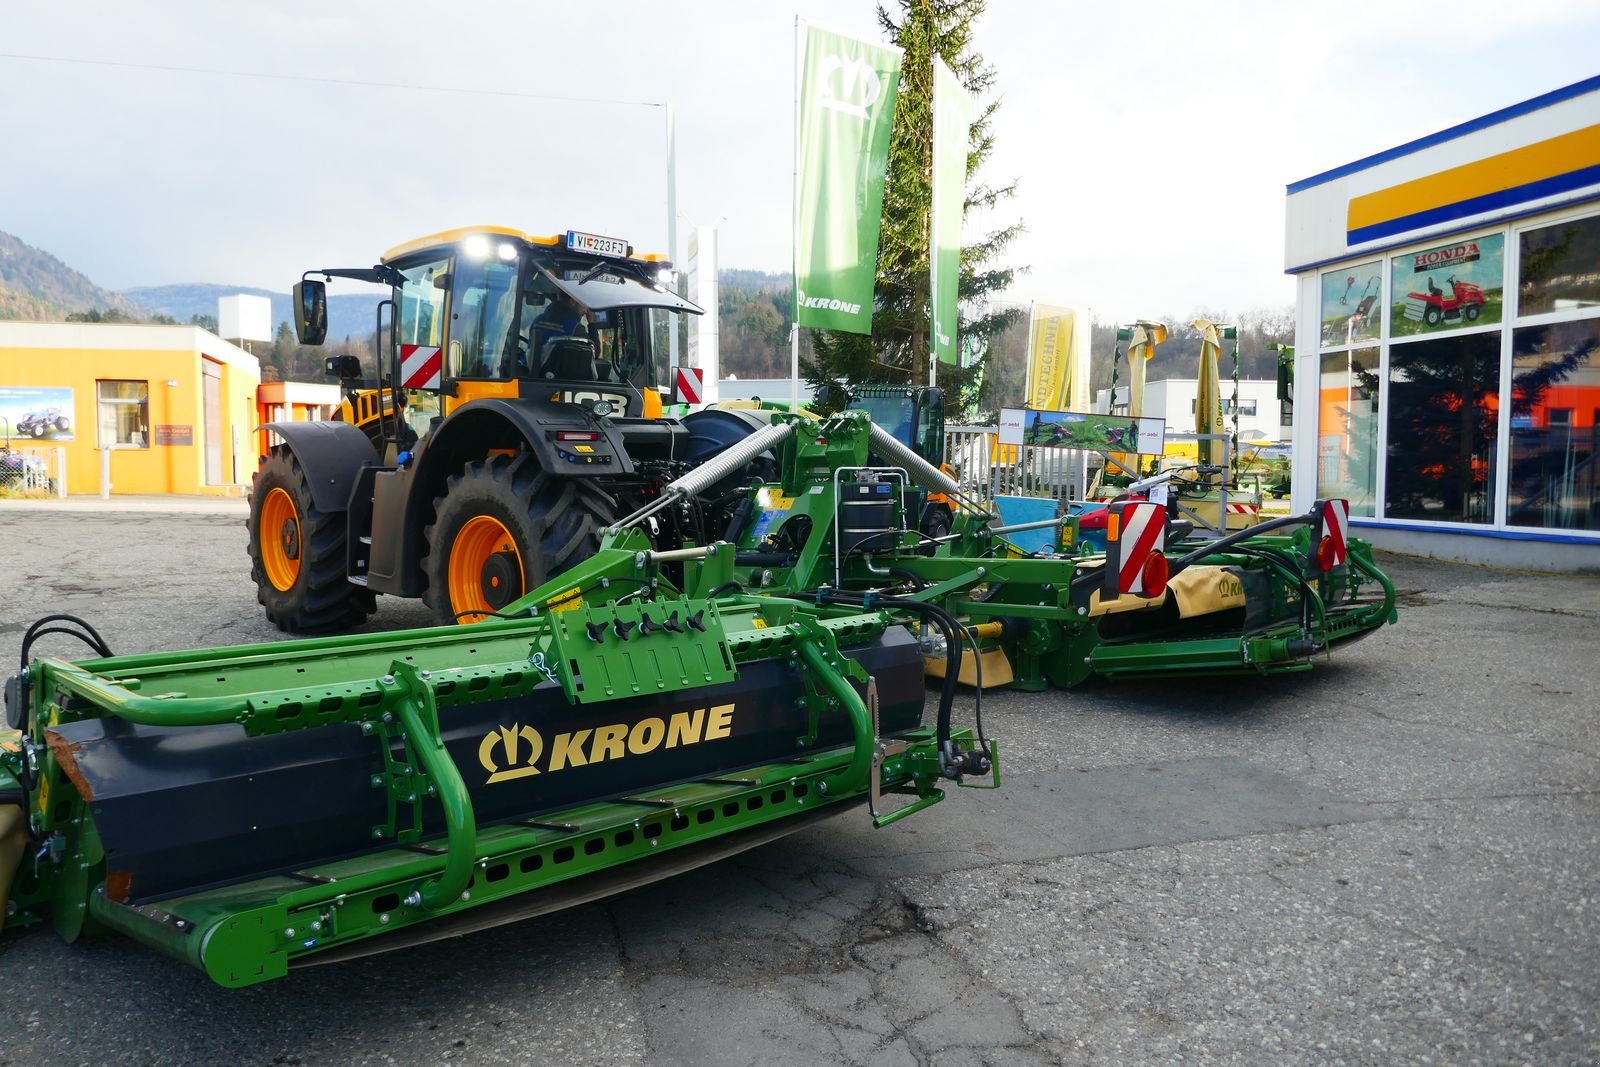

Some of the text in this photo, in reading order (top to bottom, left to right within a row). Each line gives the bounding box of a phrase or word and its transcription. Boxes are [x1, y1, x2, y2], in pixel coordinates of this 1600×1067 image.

[577, 235, 586, 248] VI
[1415, 243, 1480, 266] HONDA
[805, 297, 862, 315] KRONE
[548, 703, 736, 772] KRONE
